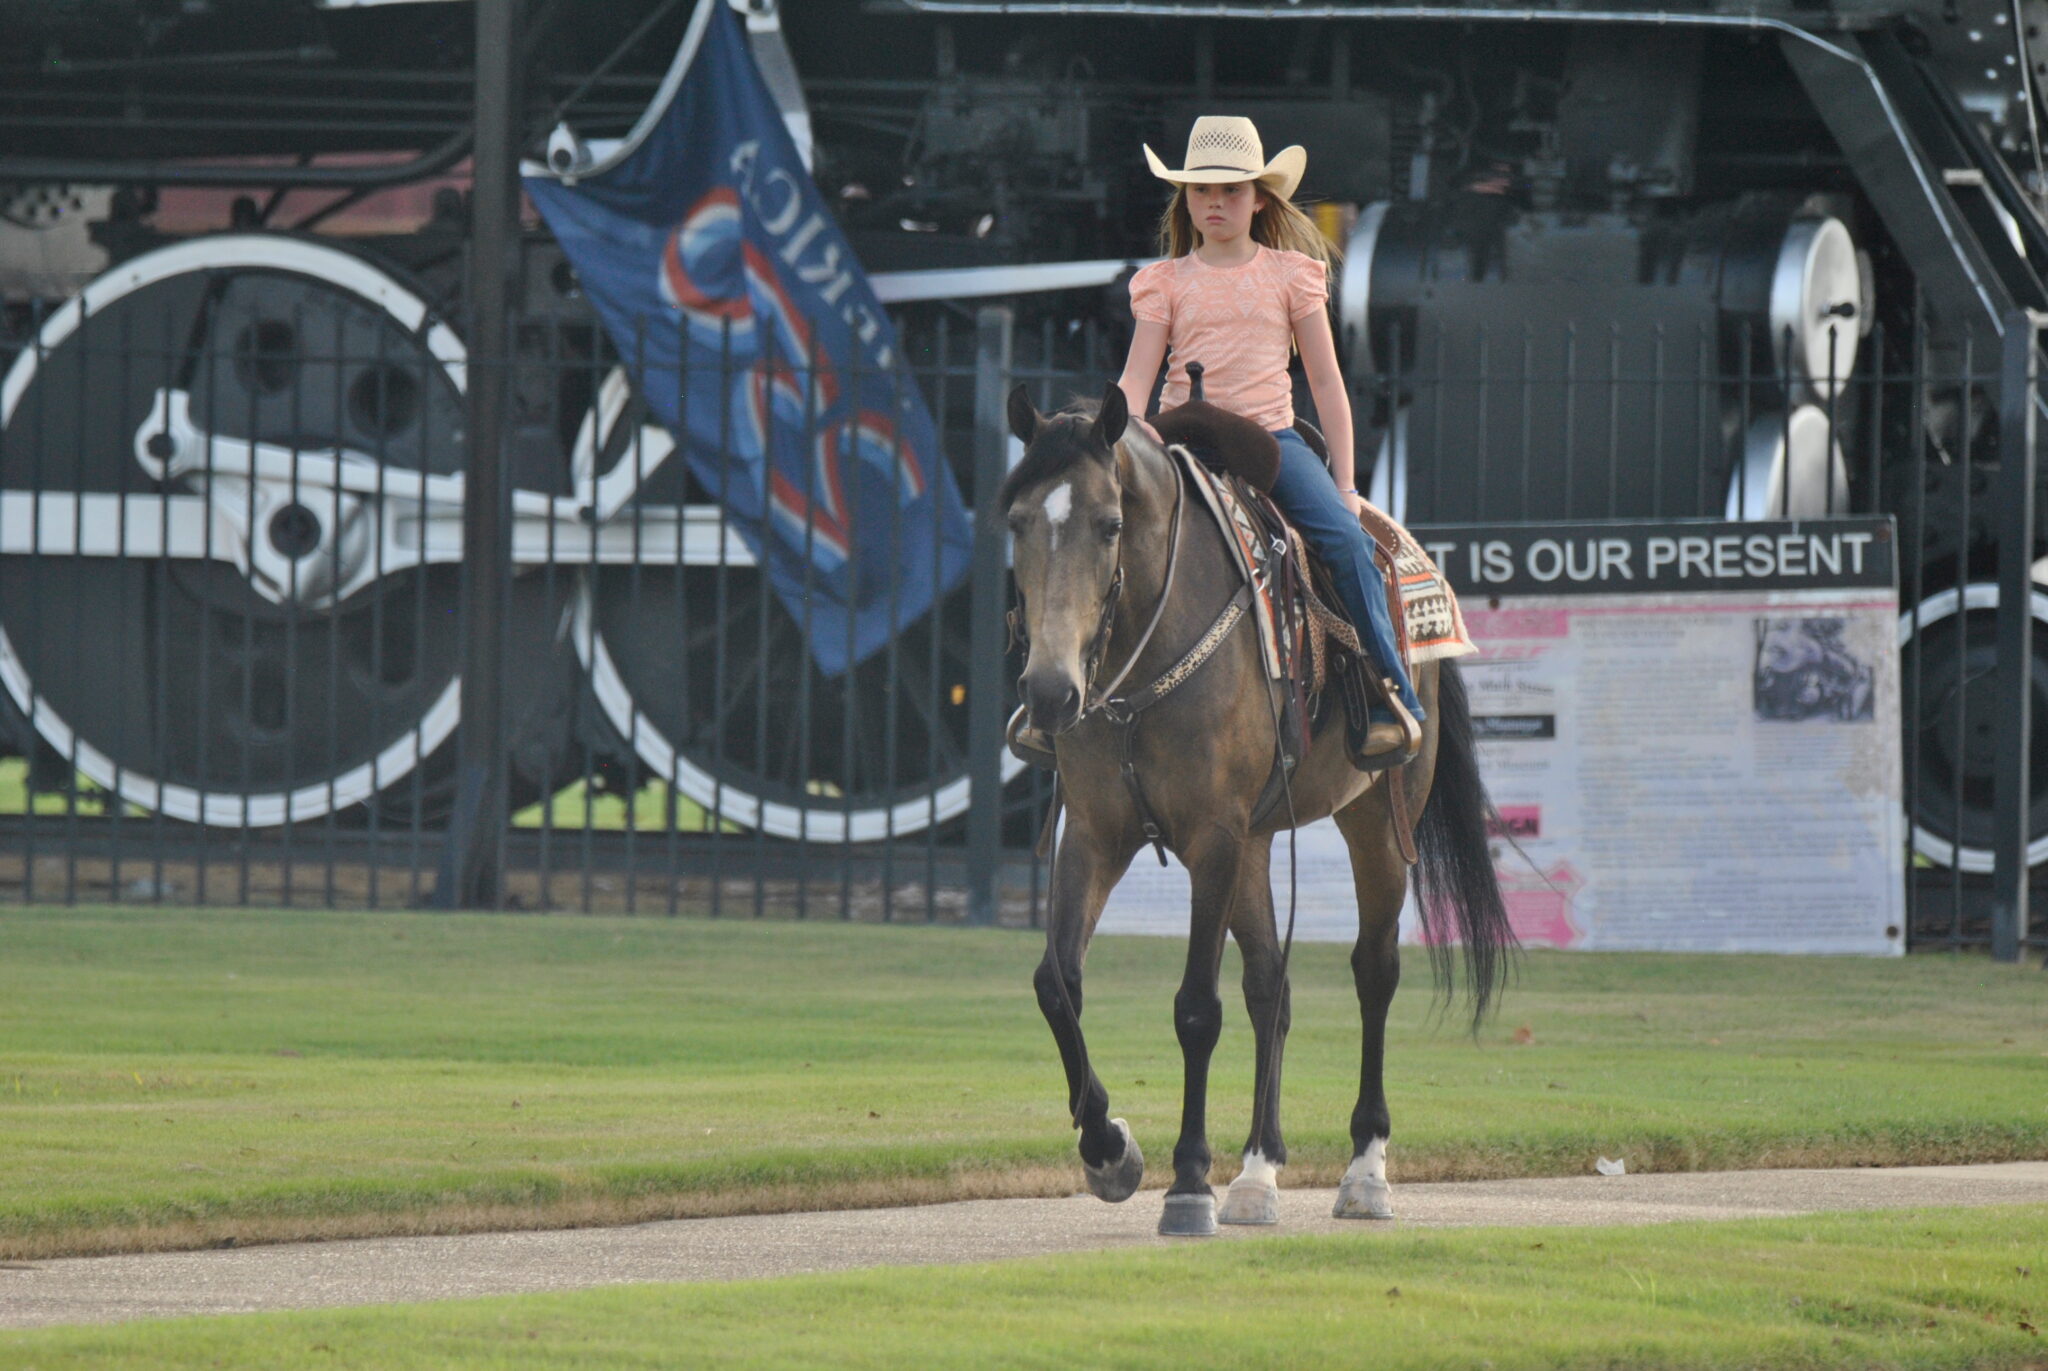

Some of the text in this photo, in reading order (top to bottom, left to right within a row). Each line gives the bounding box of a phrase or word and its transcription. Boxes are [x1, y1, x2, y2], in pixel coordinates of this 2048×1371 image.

[1469, 541, 1514, 582] IS
[1526, 538, 1633, 582] OUR
[1647, 533, 1872, 579] PRESENT
